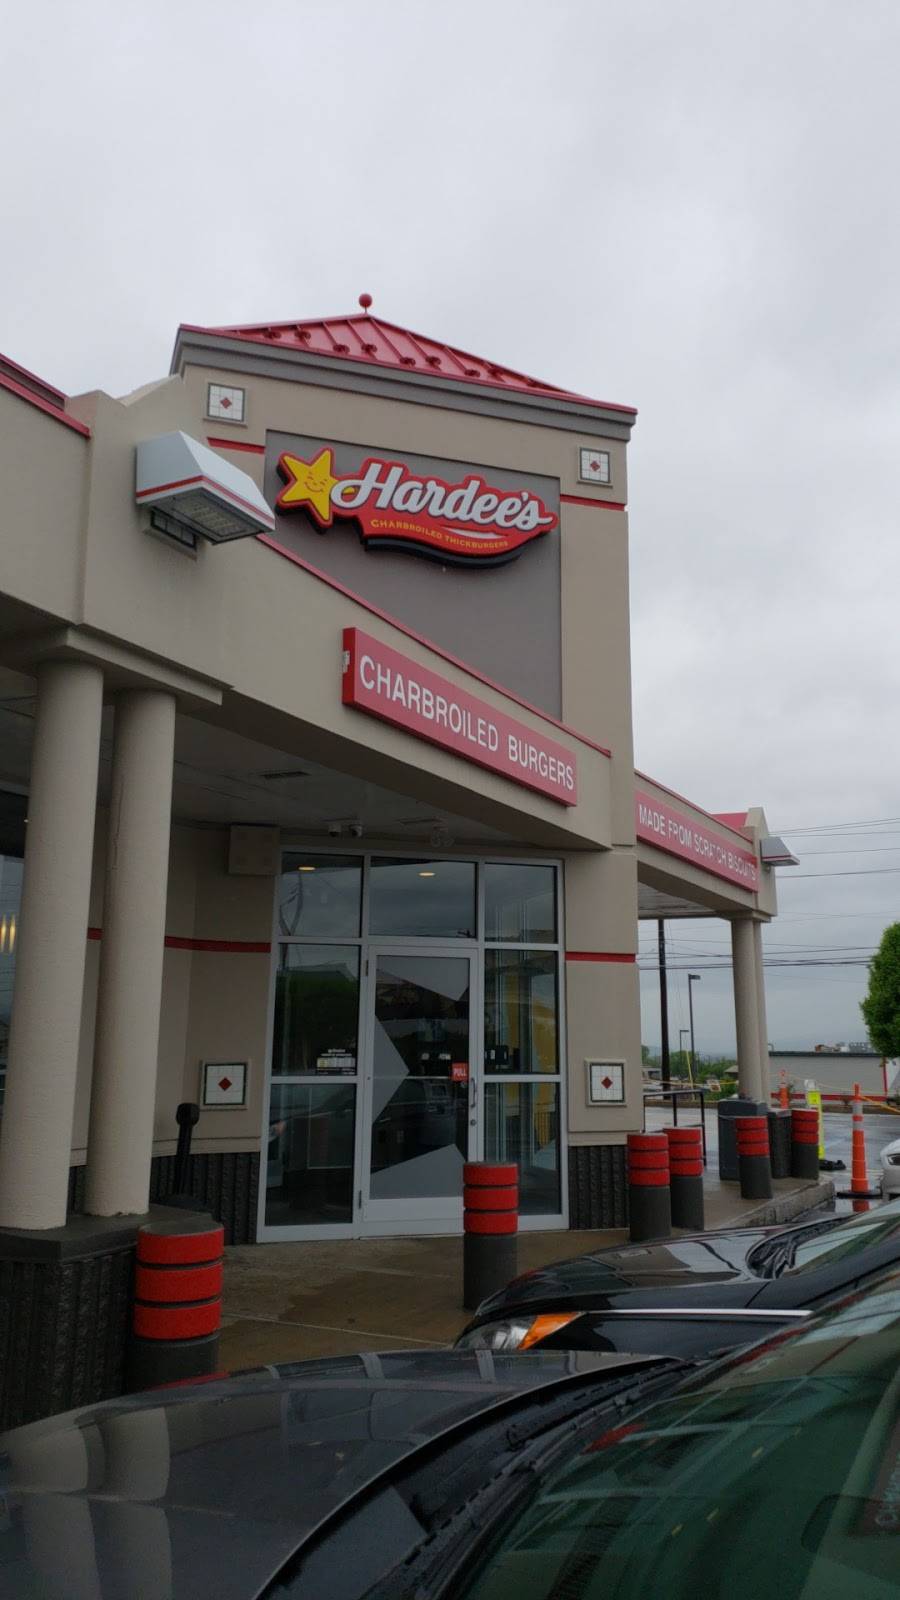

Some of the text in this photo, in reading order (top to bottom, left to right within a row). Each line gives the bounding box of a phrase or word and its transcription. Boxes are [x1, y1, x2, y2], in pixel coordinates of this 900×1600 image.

[330, 462, 553, 531] Hardee's
[370, 519, 509, 549] CHARBROILED THICKBURGERS
[360, 655, 574, 791] CHARBROILED BURGERS
[639, 804, 666, 836] MADE
[668, 820, 692, 849] FROM
